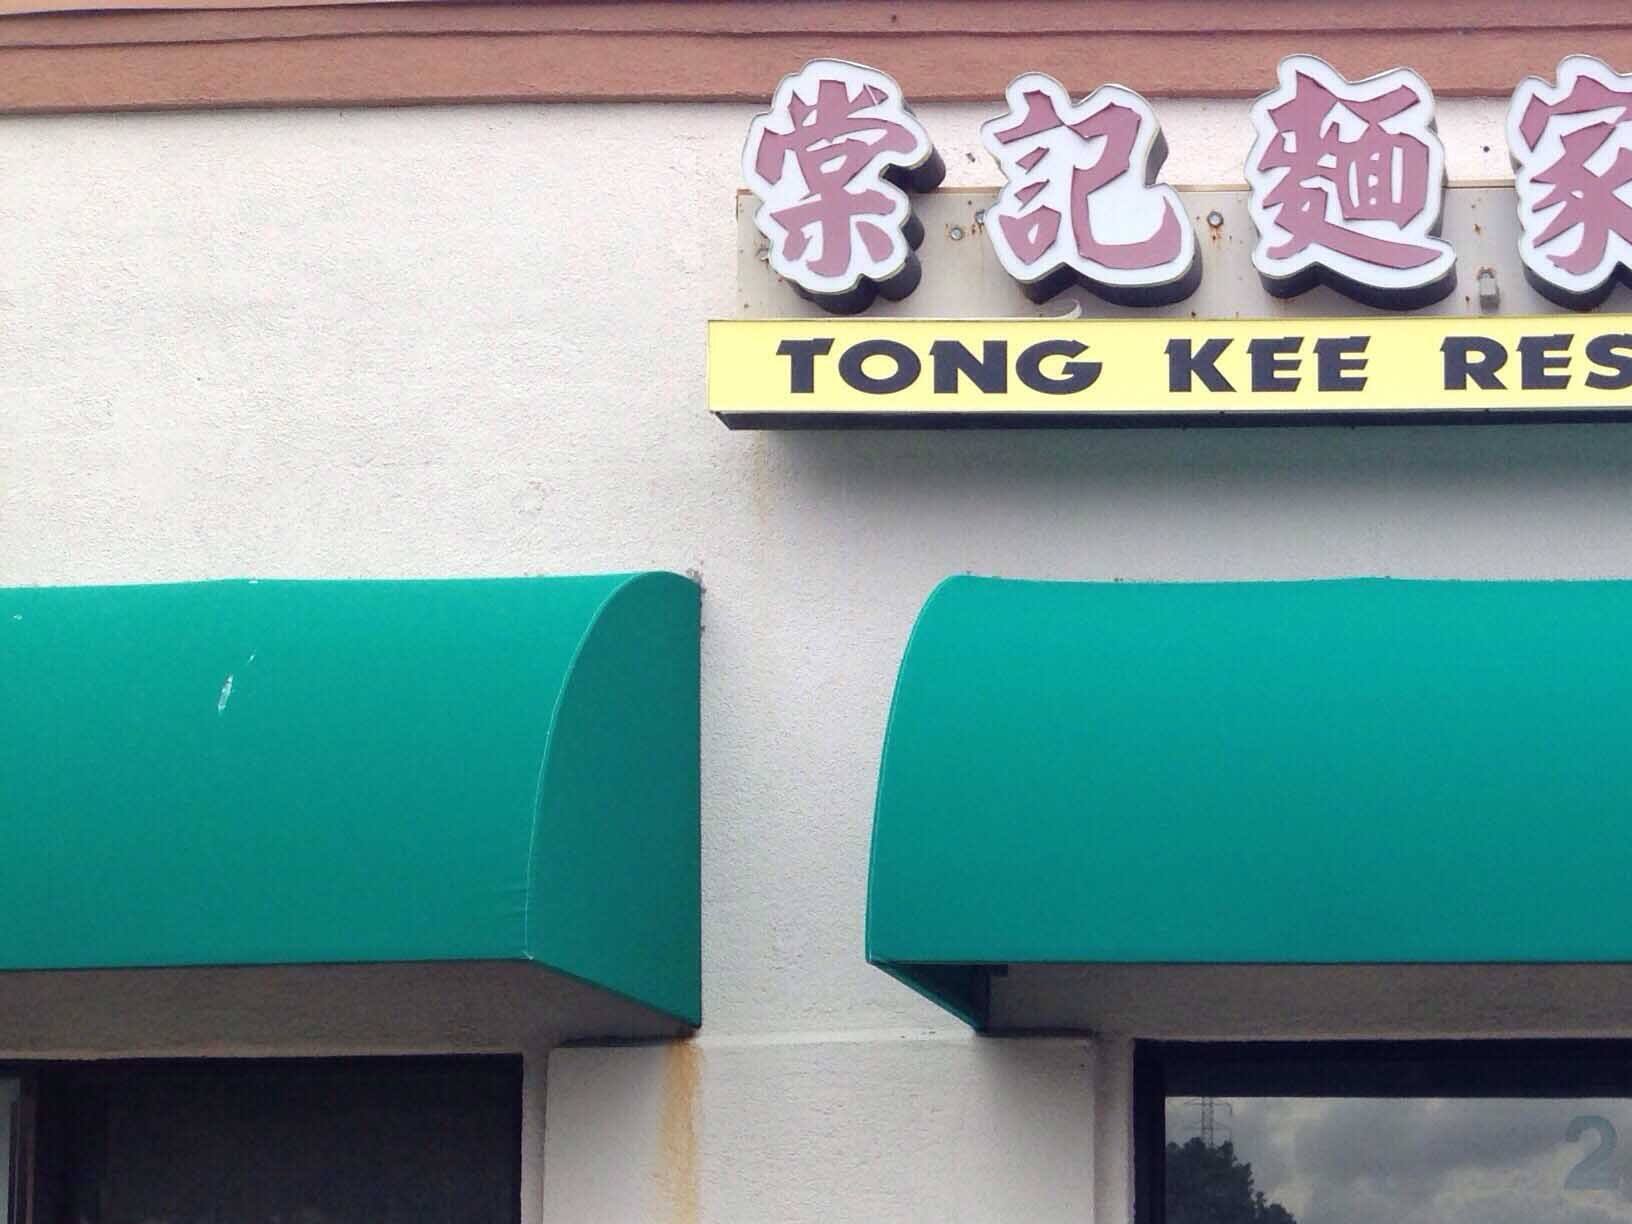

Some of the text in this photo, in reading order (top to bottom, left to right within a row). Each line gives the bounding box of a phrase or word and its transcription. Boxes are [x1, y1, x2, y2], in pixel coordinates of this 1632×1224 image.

[776, 336, 1102, 395] TONG
[1165, 335, 1371, 393] KEE
[1563, 1114, 1620, 1190] 2
